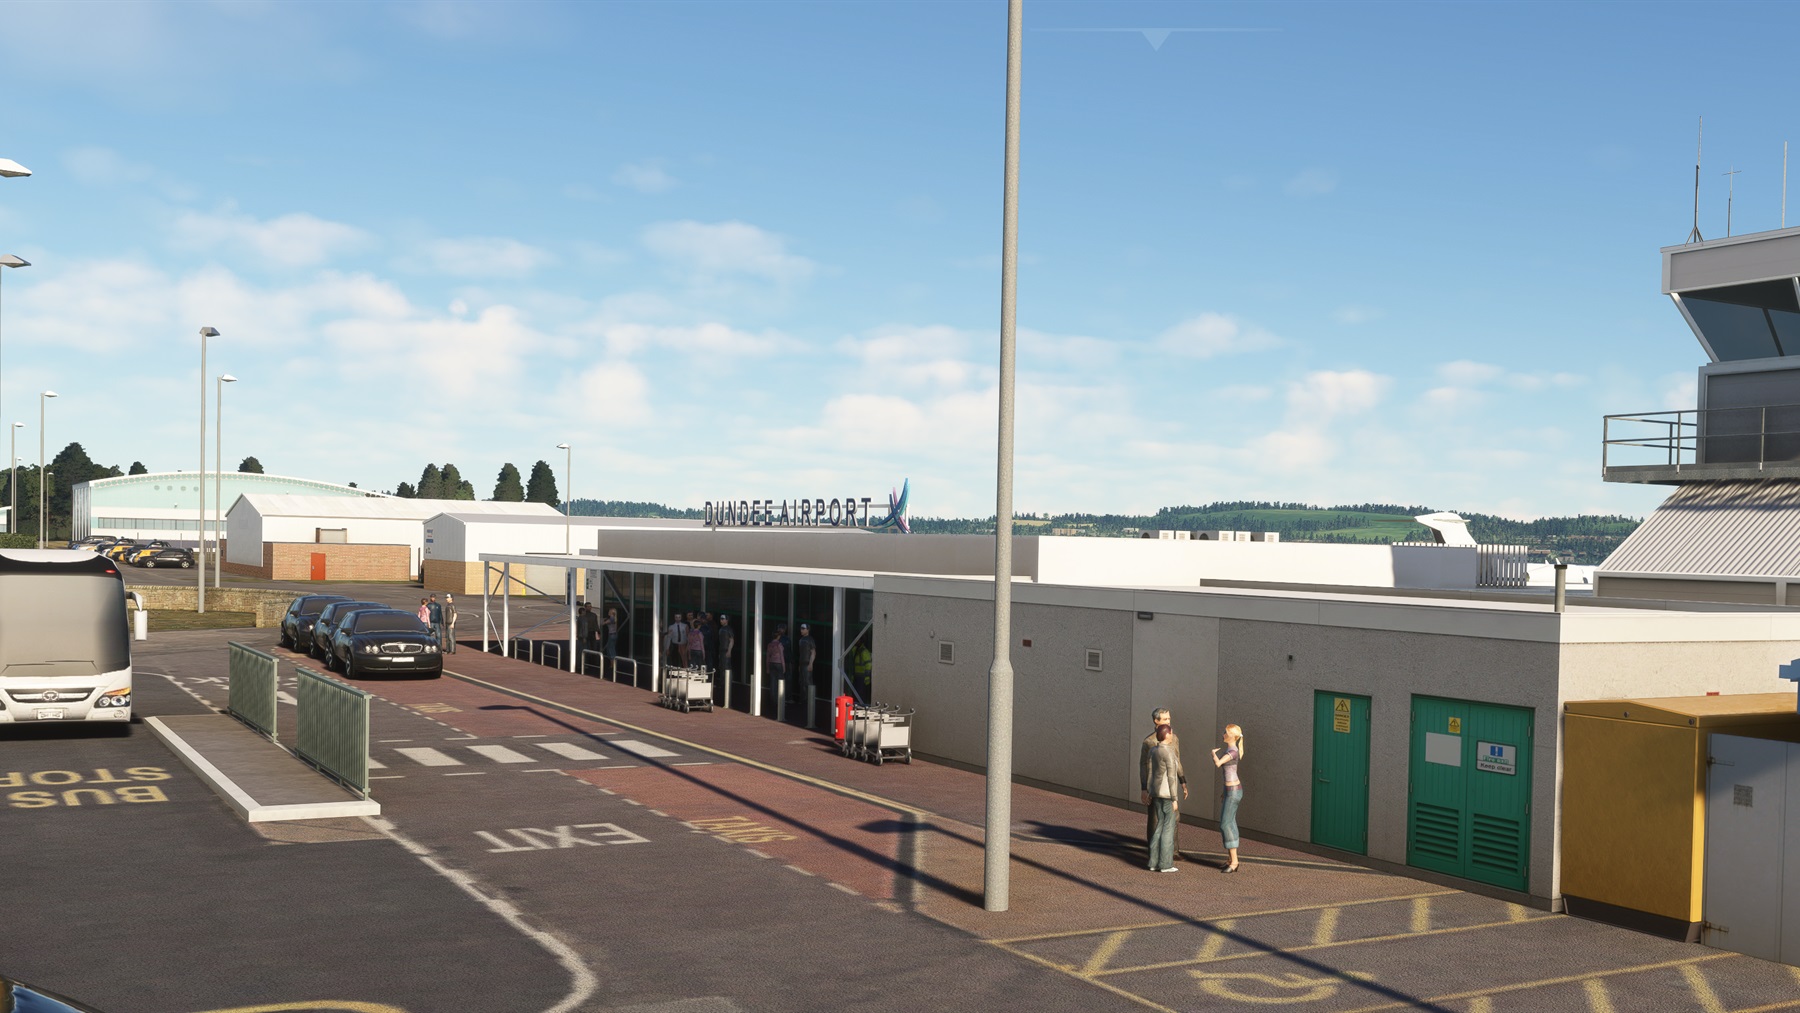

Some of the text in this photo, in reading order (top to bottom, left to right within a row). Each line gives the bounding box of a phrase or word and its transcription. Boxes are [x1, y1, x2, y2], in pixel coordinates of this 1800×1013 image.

[705, 497, 872, 527] DUNDEE AIRPORT
[7, 785, 170, 808] BUS
[472, 822, 652, 853] EXIT
